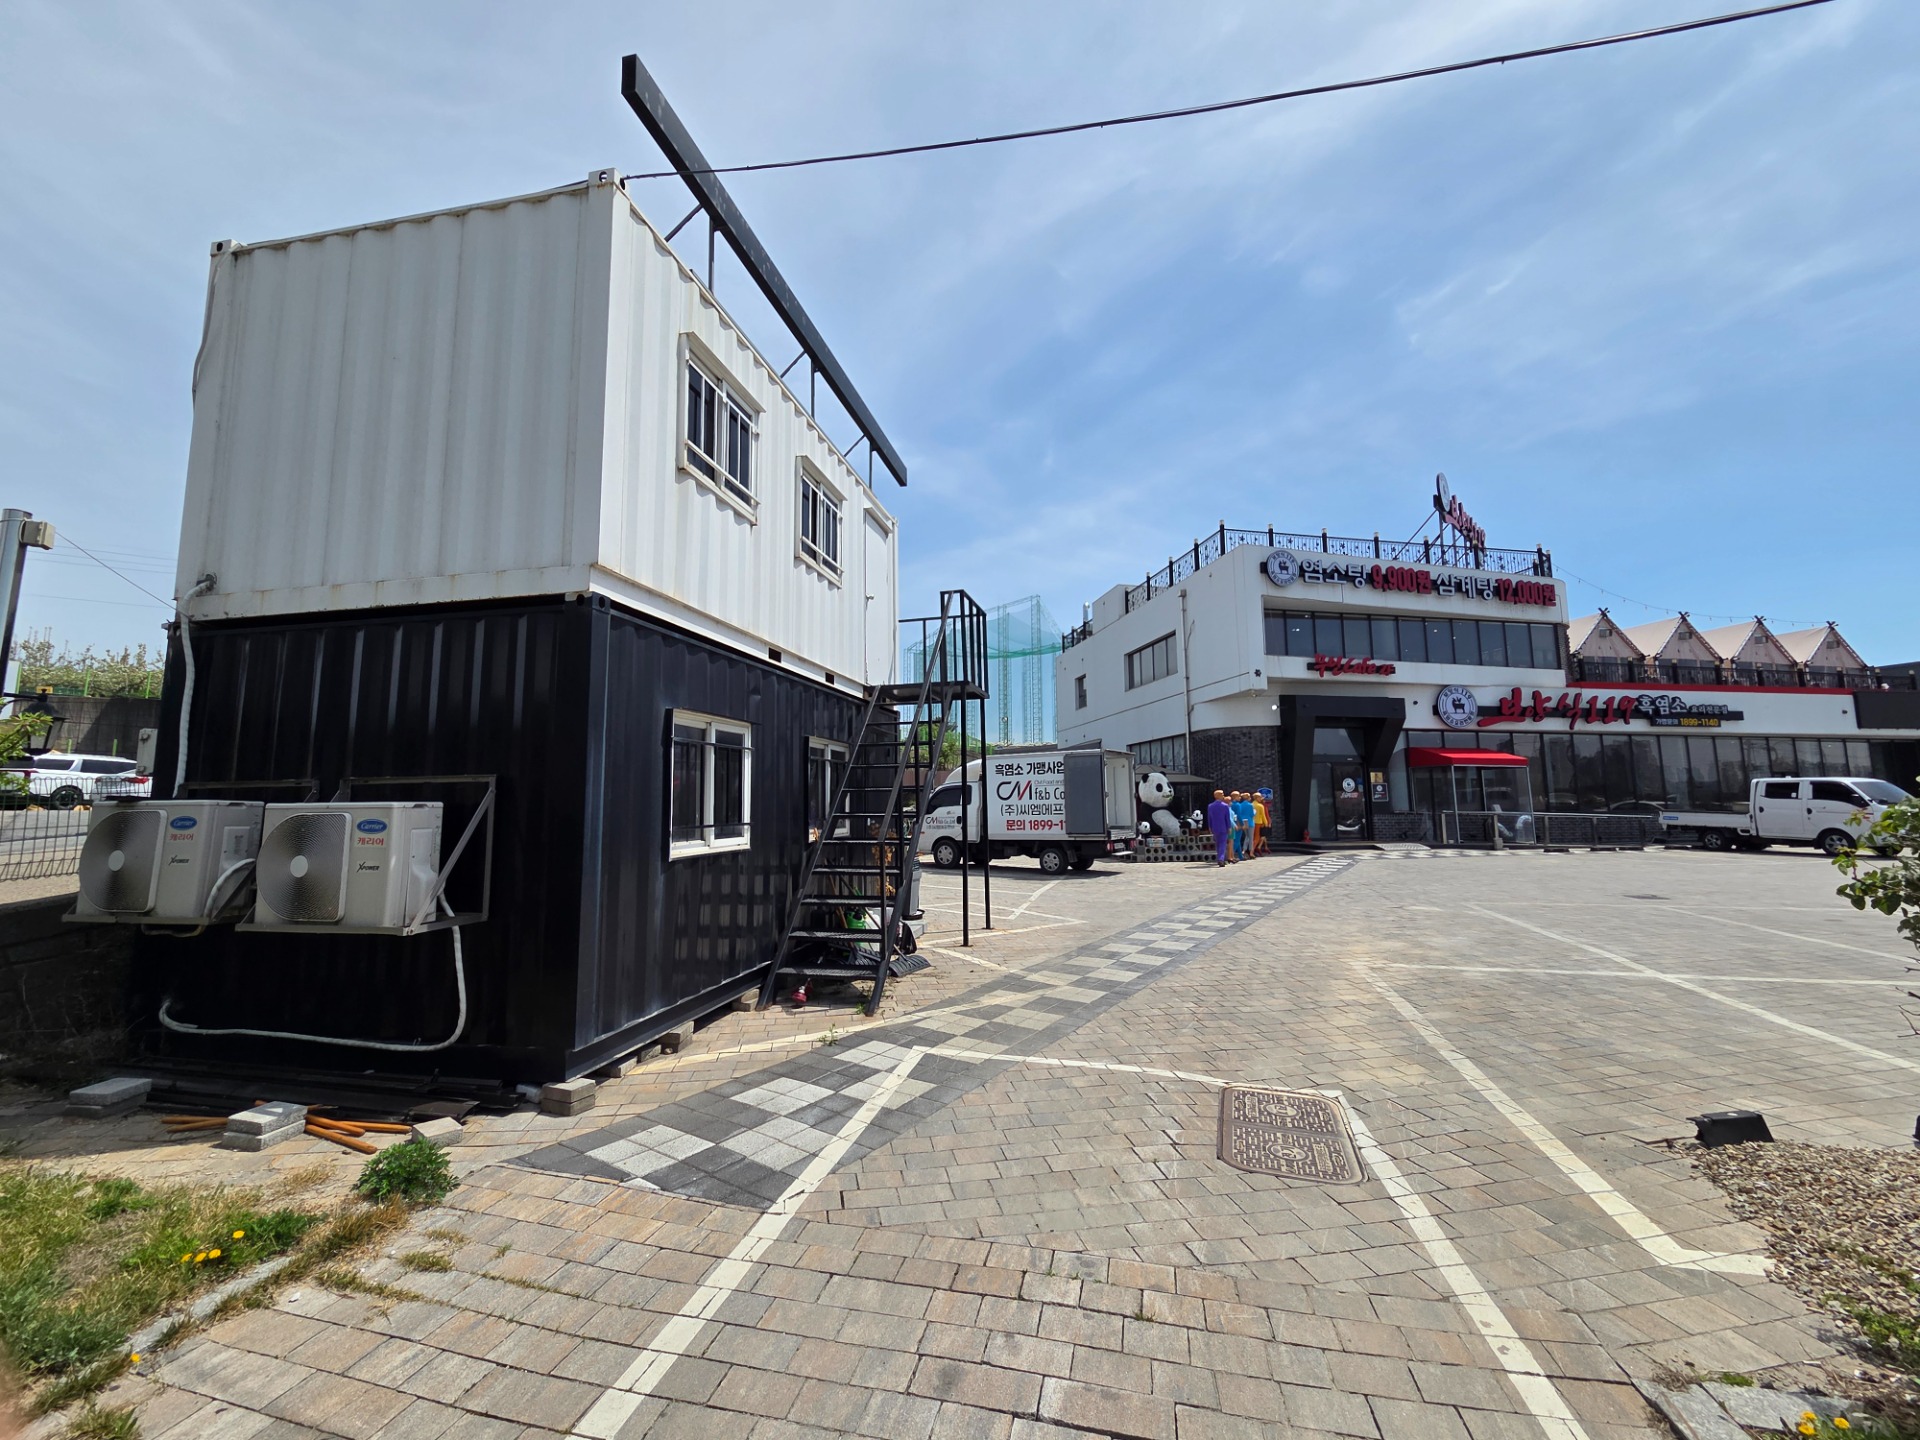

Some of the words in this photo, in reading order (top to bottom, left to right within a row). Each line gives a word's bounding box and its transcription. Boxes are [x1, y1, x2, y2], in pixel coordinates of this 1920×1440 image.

[1302, 559, 1367, 589] 염소탕
[1371, 564, 1432, 594] 9,900원
[1436, 573, 1498, 600] 삼계탕
[1496, 578, 1557, 607] 12,000원
[1638, 694, 1688, 715] 흑염소
[1680, 718, 1719, 726] 1899-1140
[995, 763, 1024, 777] 흑염소
[1026, 761, 1065, 775] 가맹사업
[1035, 787, 1051, 800] f&b
[360, 822, 384, 830] Carrier
[1006, 819, 1026, 831] 문의
[169, 833, 194, 841] 캐리어
[357, 837, 384, 846] 캐리어
